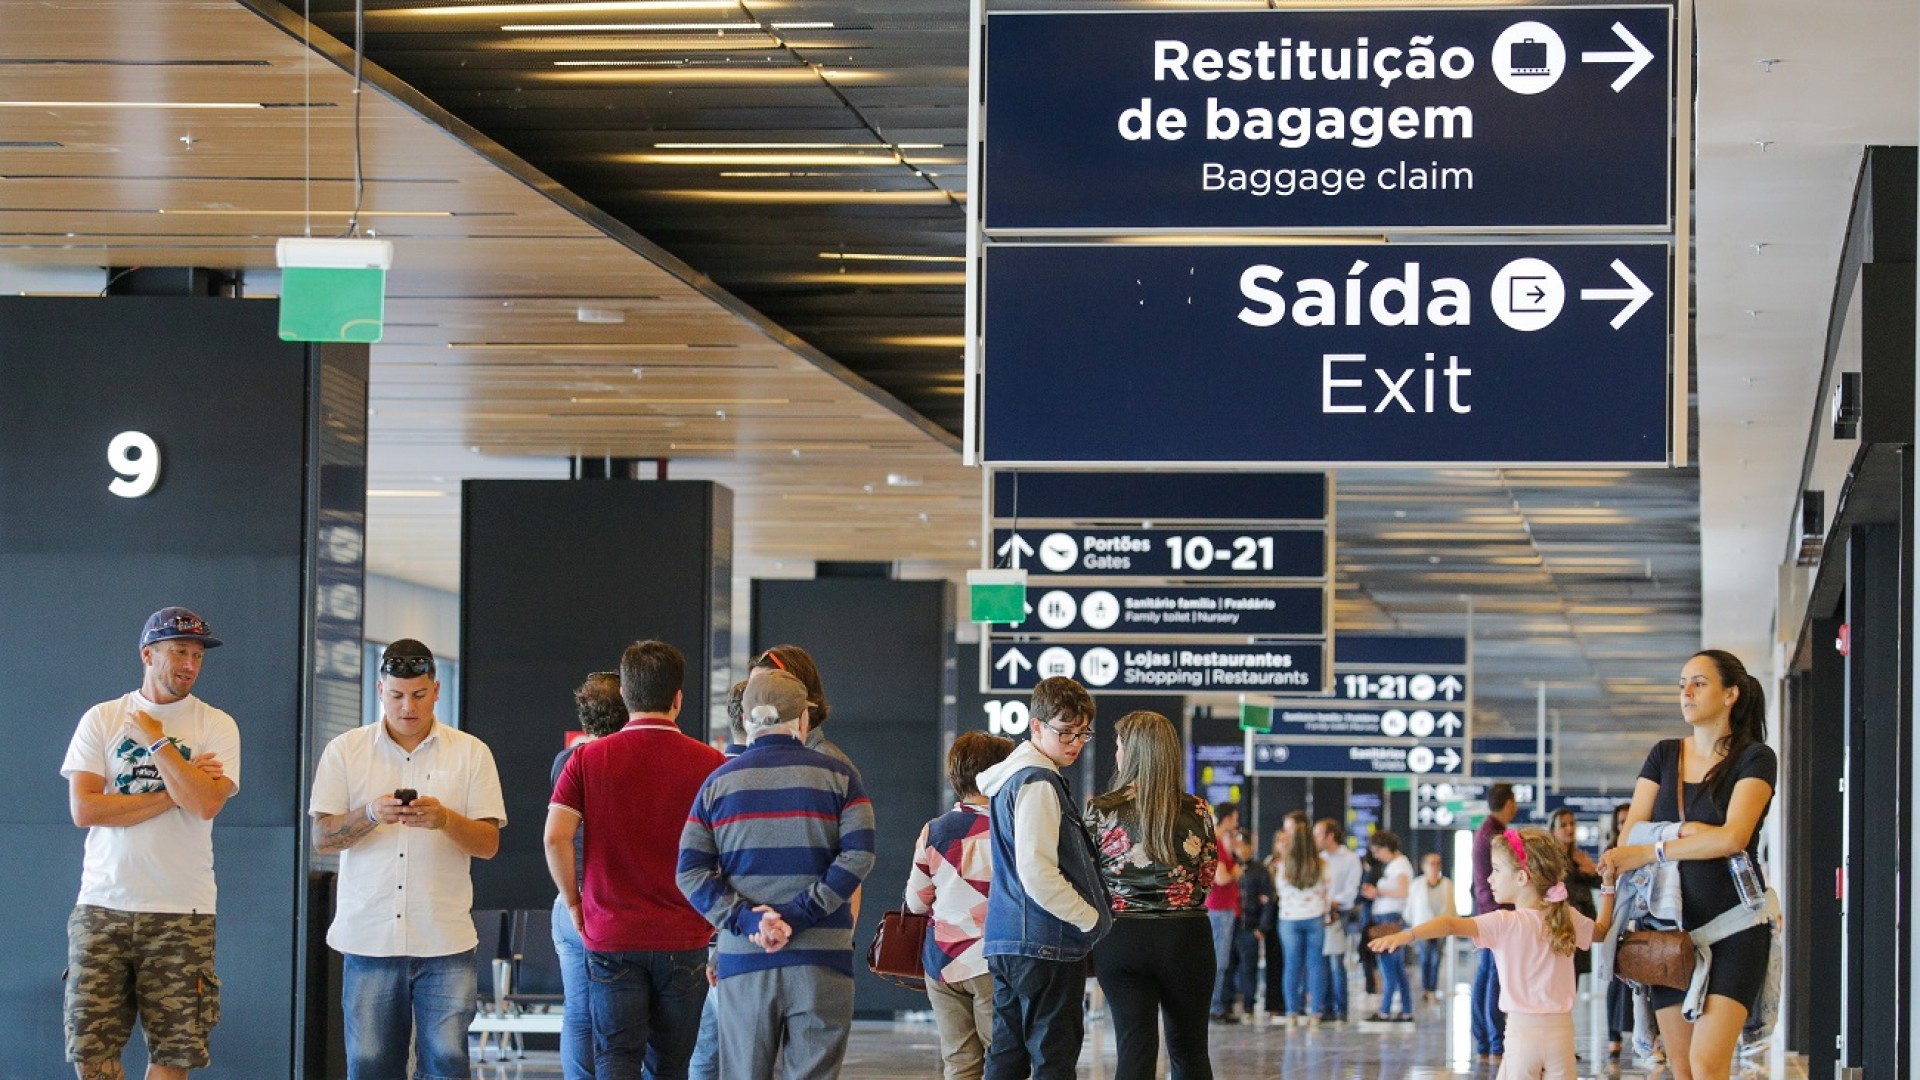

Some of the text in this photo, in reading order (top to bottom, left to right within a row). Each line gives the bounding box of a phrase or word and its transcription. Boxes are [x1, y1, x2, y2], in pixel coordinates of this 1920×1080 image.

[1154, 34, 1475, 89] Restituição
[1117, 96, 1474, 149] de bagagem
[1202, 160, 1474, 197] Baggage claim
[1237, 259, 1471, 327] Saída
[1322, 352, 1472, 414] Exit
[107, 430, 160, 498] 9
[1083, 534, 1274, 571] Portões 10-21
[1083, 553, 1131, 570] Gates
[1124, 650, 1292, 669] Lojas Restaurantes
[1124, 668, 1309, 687] Shopping Restaurants
[1344, 674, 1407, 699] 11-21
[983, 699, 1029, 736] 10
